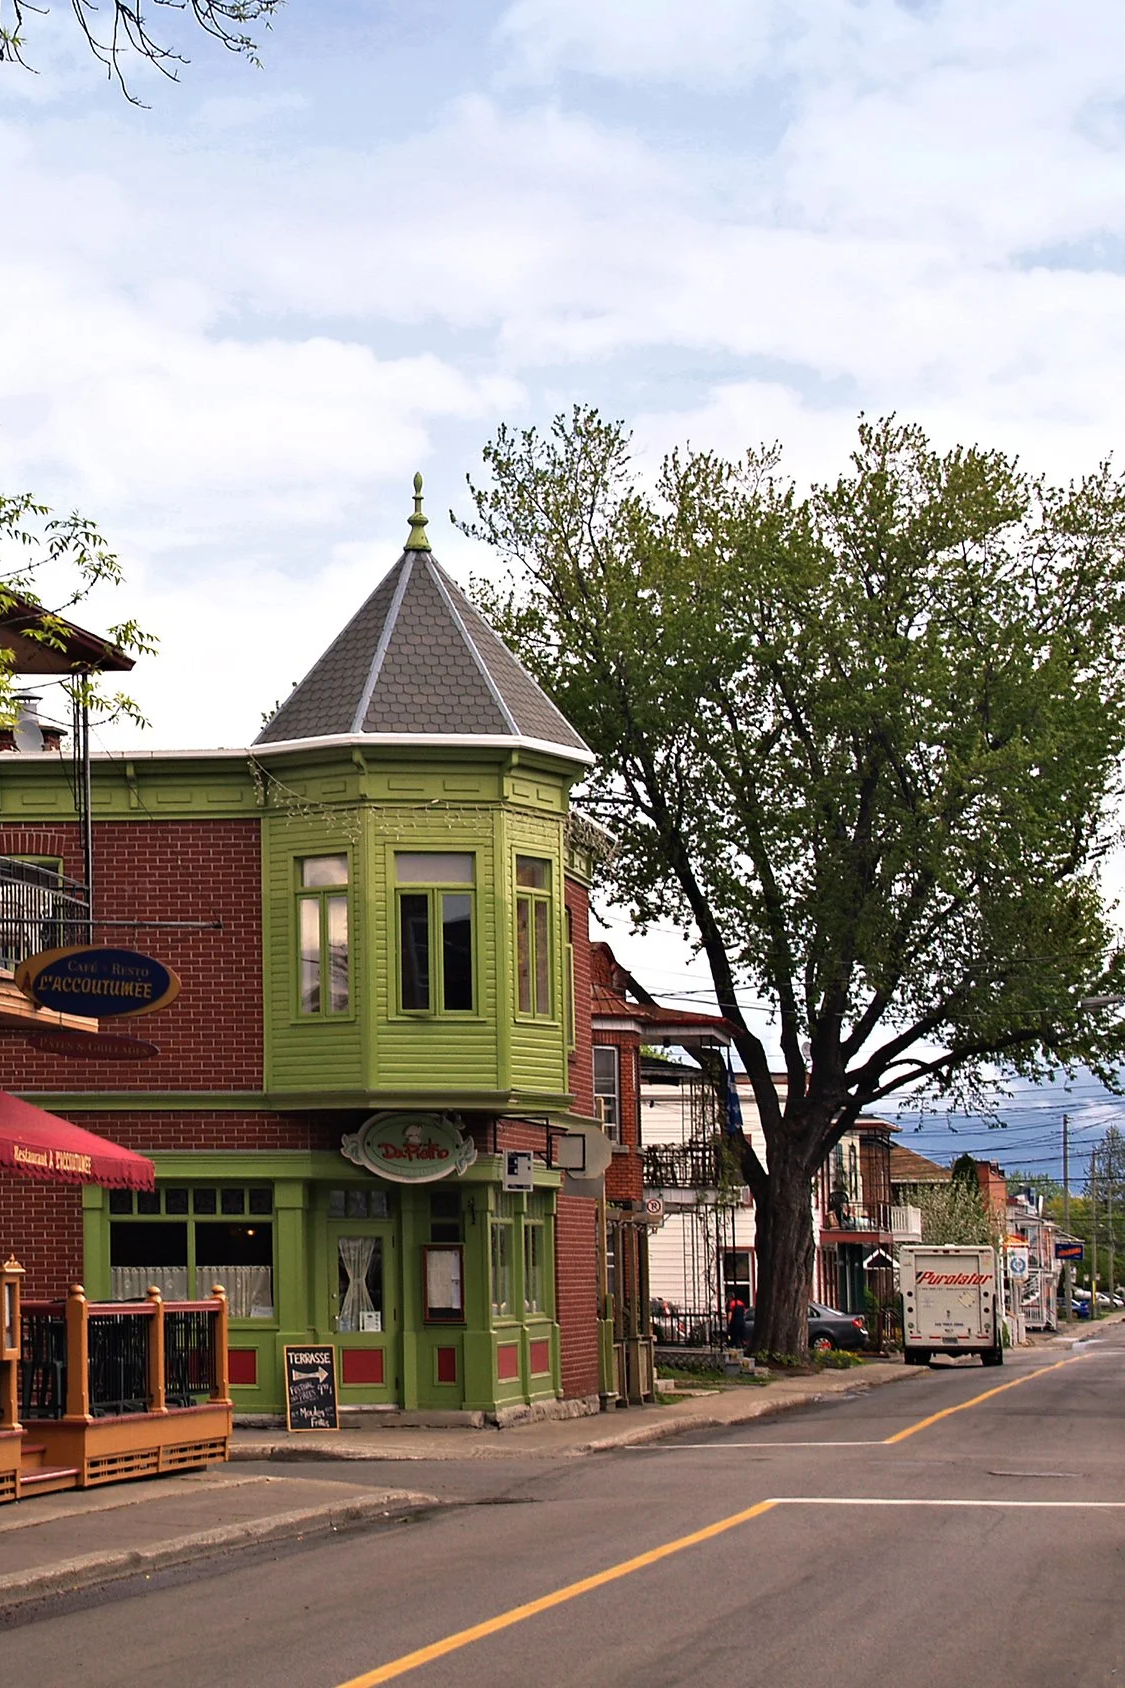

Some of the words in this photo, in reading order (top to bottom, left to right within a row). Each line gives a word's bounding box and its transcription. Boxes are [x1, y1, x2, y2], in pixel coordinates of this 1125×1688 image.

[112, 962, 149, 977] RESTO
[14, 1145, 48, 1167] Restaurant
[916, 1271, 993, 1285] Purolator
[288, 1352, 331, 1364] TERRASSE
